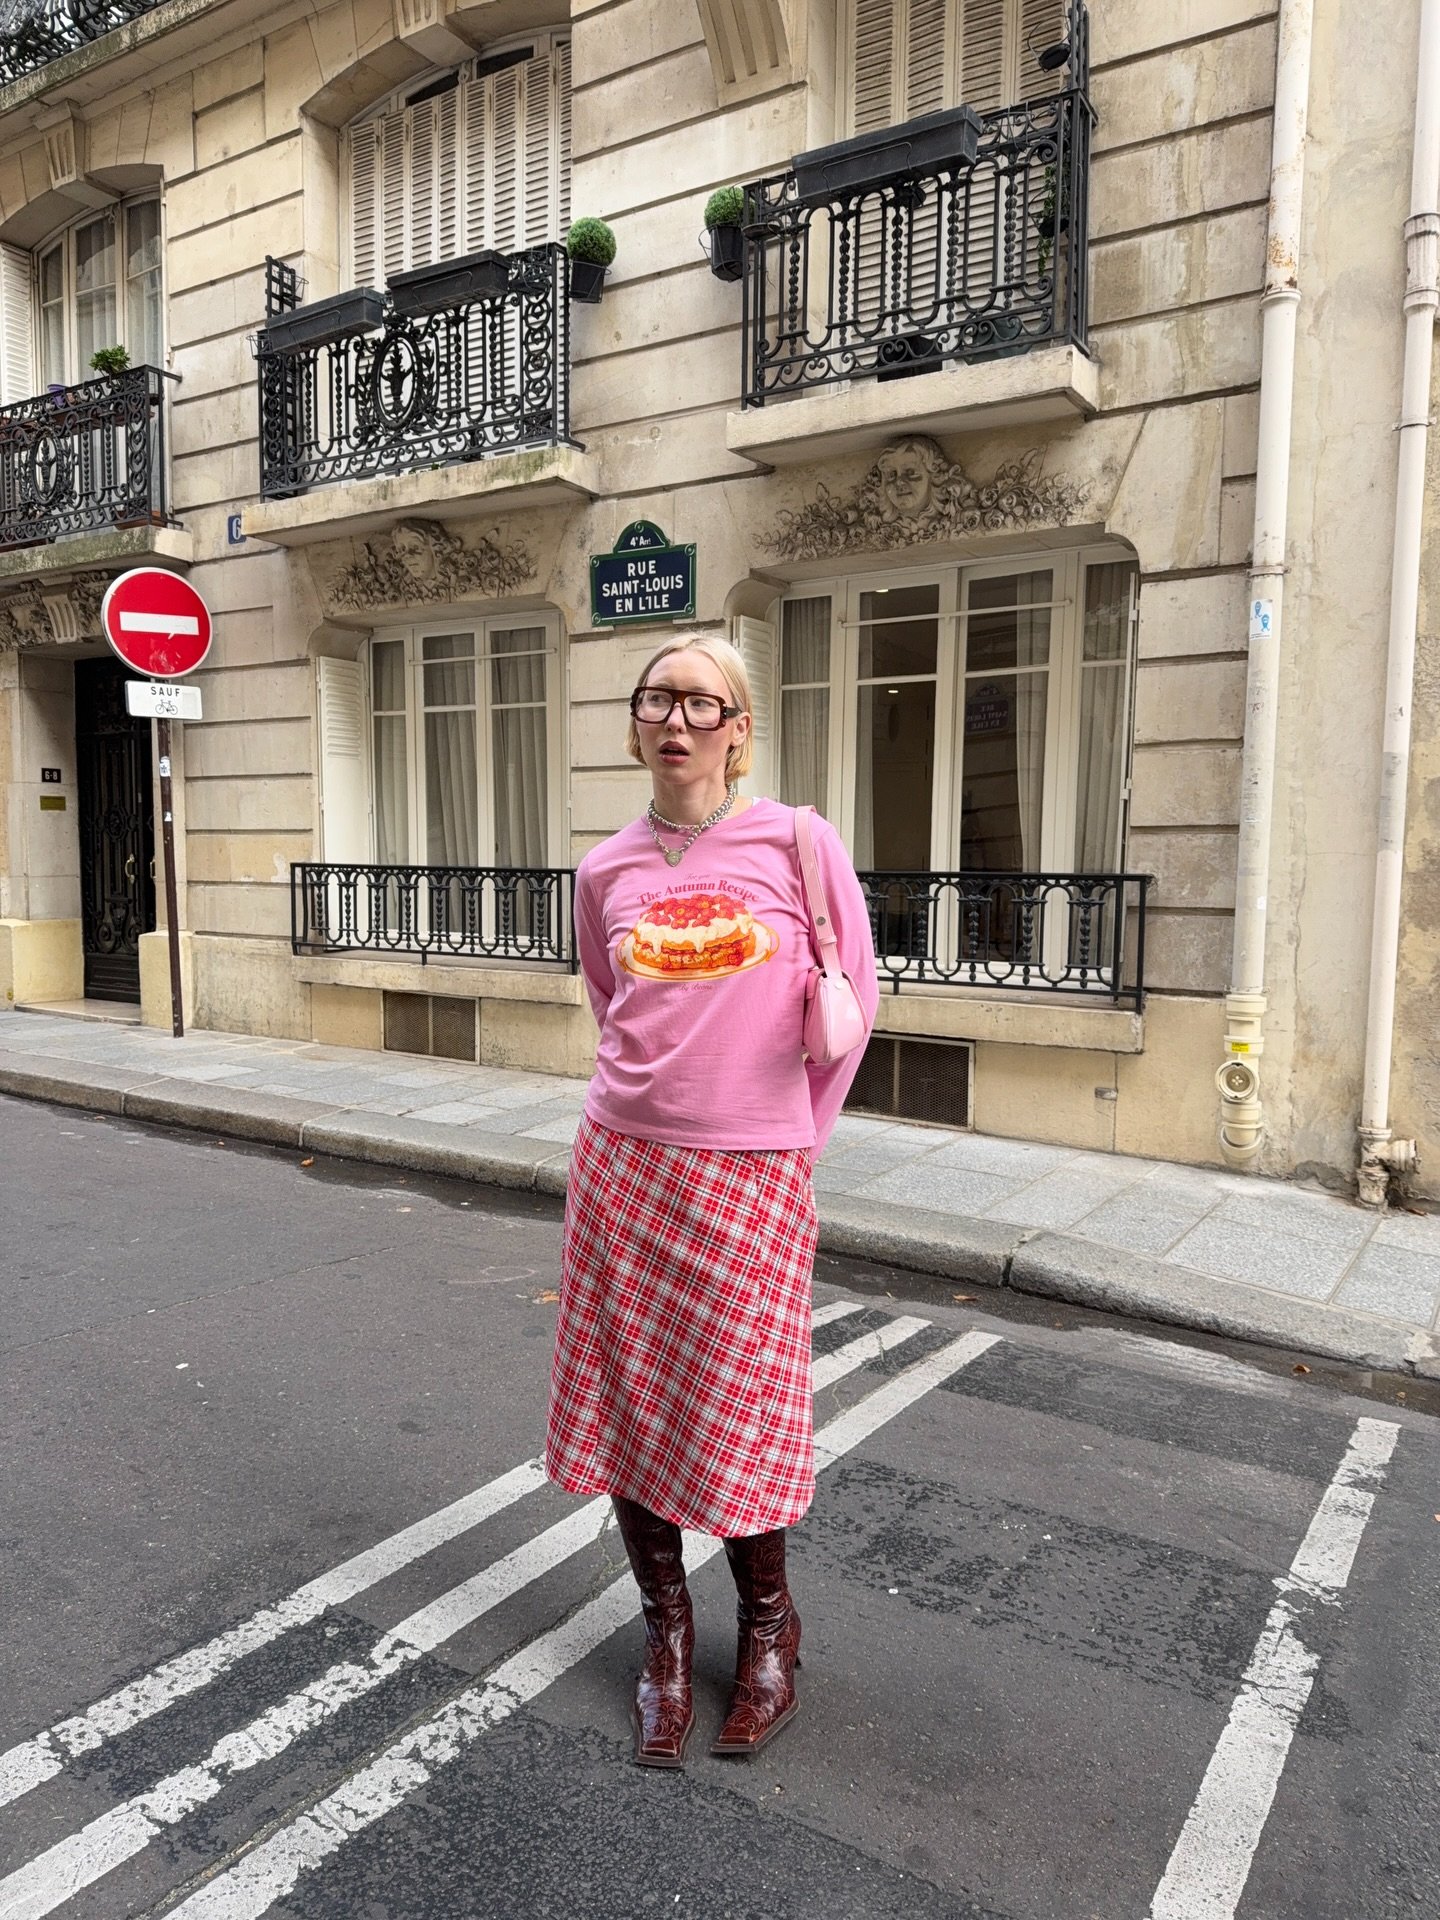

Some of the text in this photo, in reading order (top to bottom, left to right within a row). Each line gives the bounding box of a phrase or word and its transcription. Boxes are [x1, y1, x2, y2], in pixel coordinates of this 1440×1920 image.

[232, 517, 241, 540] 6
[627, 560, 657, 577] RUE
[602, 574, 684, 597] SAINT-LOUIS
[615, 598, 633, 613] EN
[150, 686, 180, 697] SAUF
[637, 879, 760, 906] The Autumn Recipe
